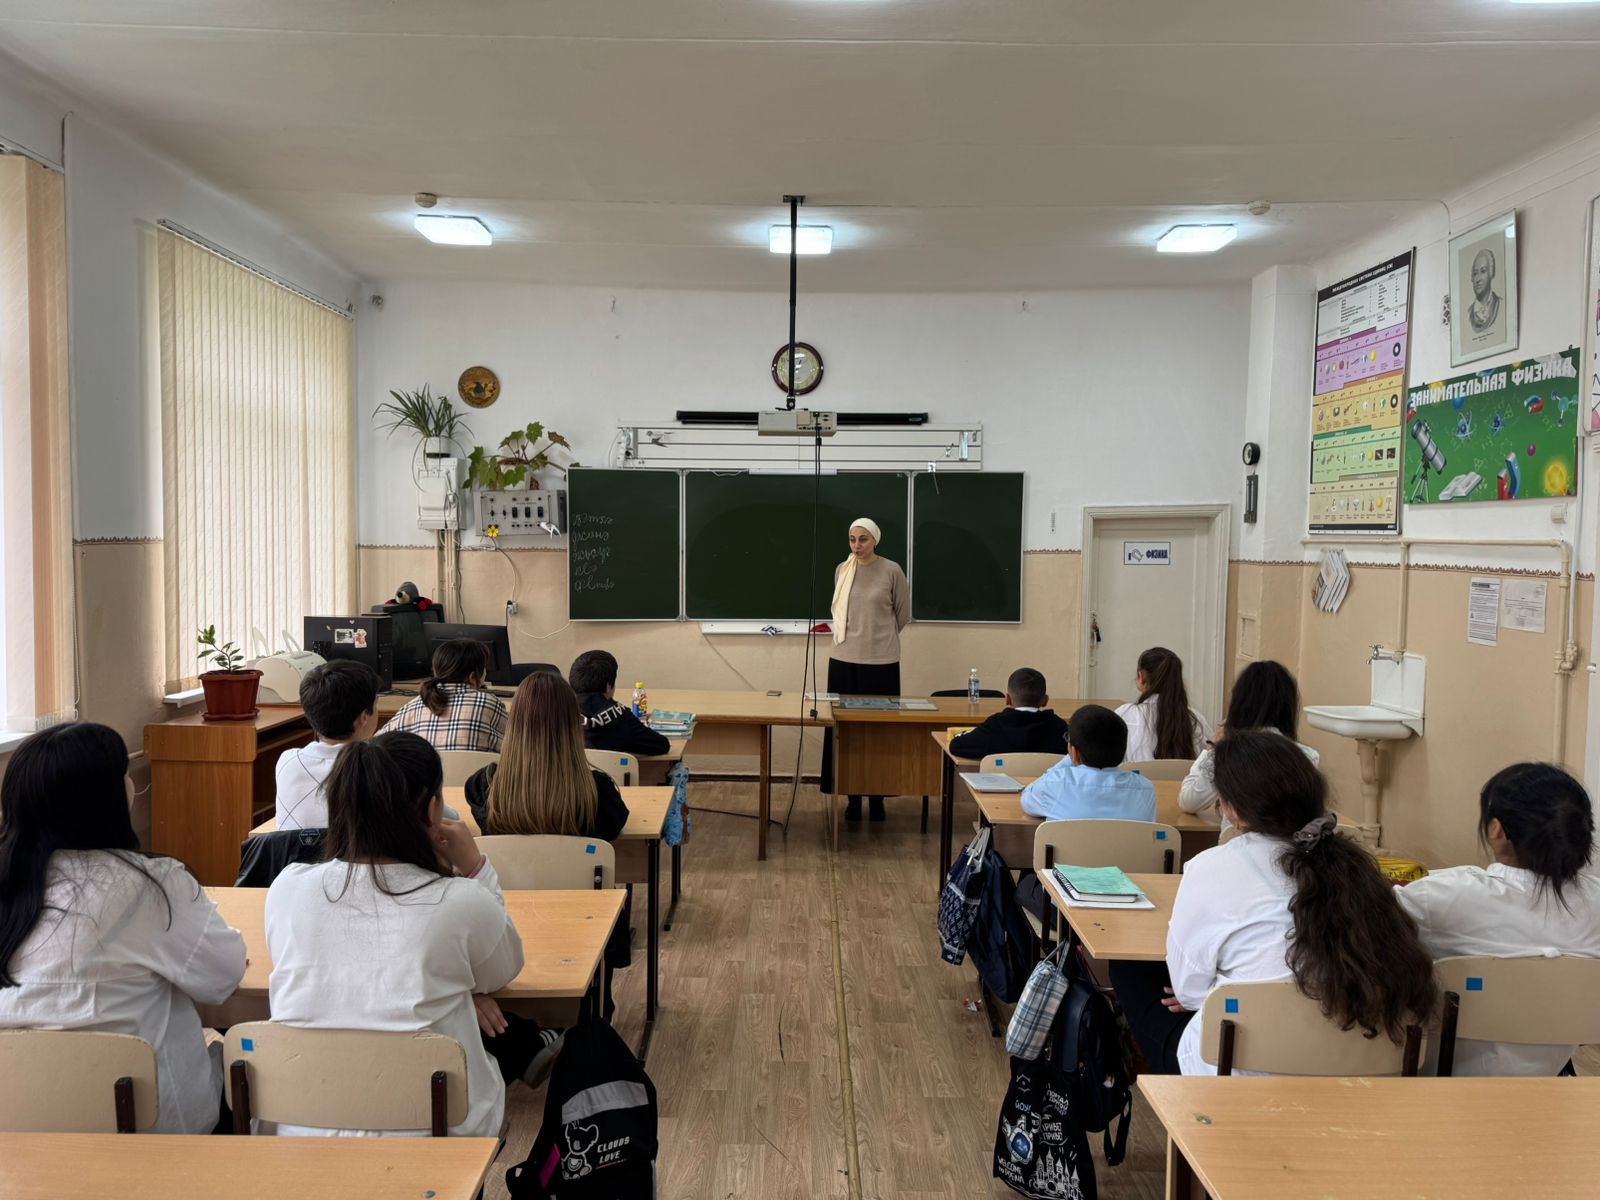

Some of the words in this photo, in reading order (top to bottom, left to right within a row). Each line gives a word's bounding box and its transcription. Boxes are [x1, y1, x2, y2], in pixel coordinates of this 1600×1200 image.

[1409, 371, 1507, 407] ЗАНИМАТЕЛЬНАЯ
[1511, 356, 1576, 386] ФИЗИКА
[597, 1136, 629, 1152] CLOUDS
[599, 1150, 620, 1163] LOVE
